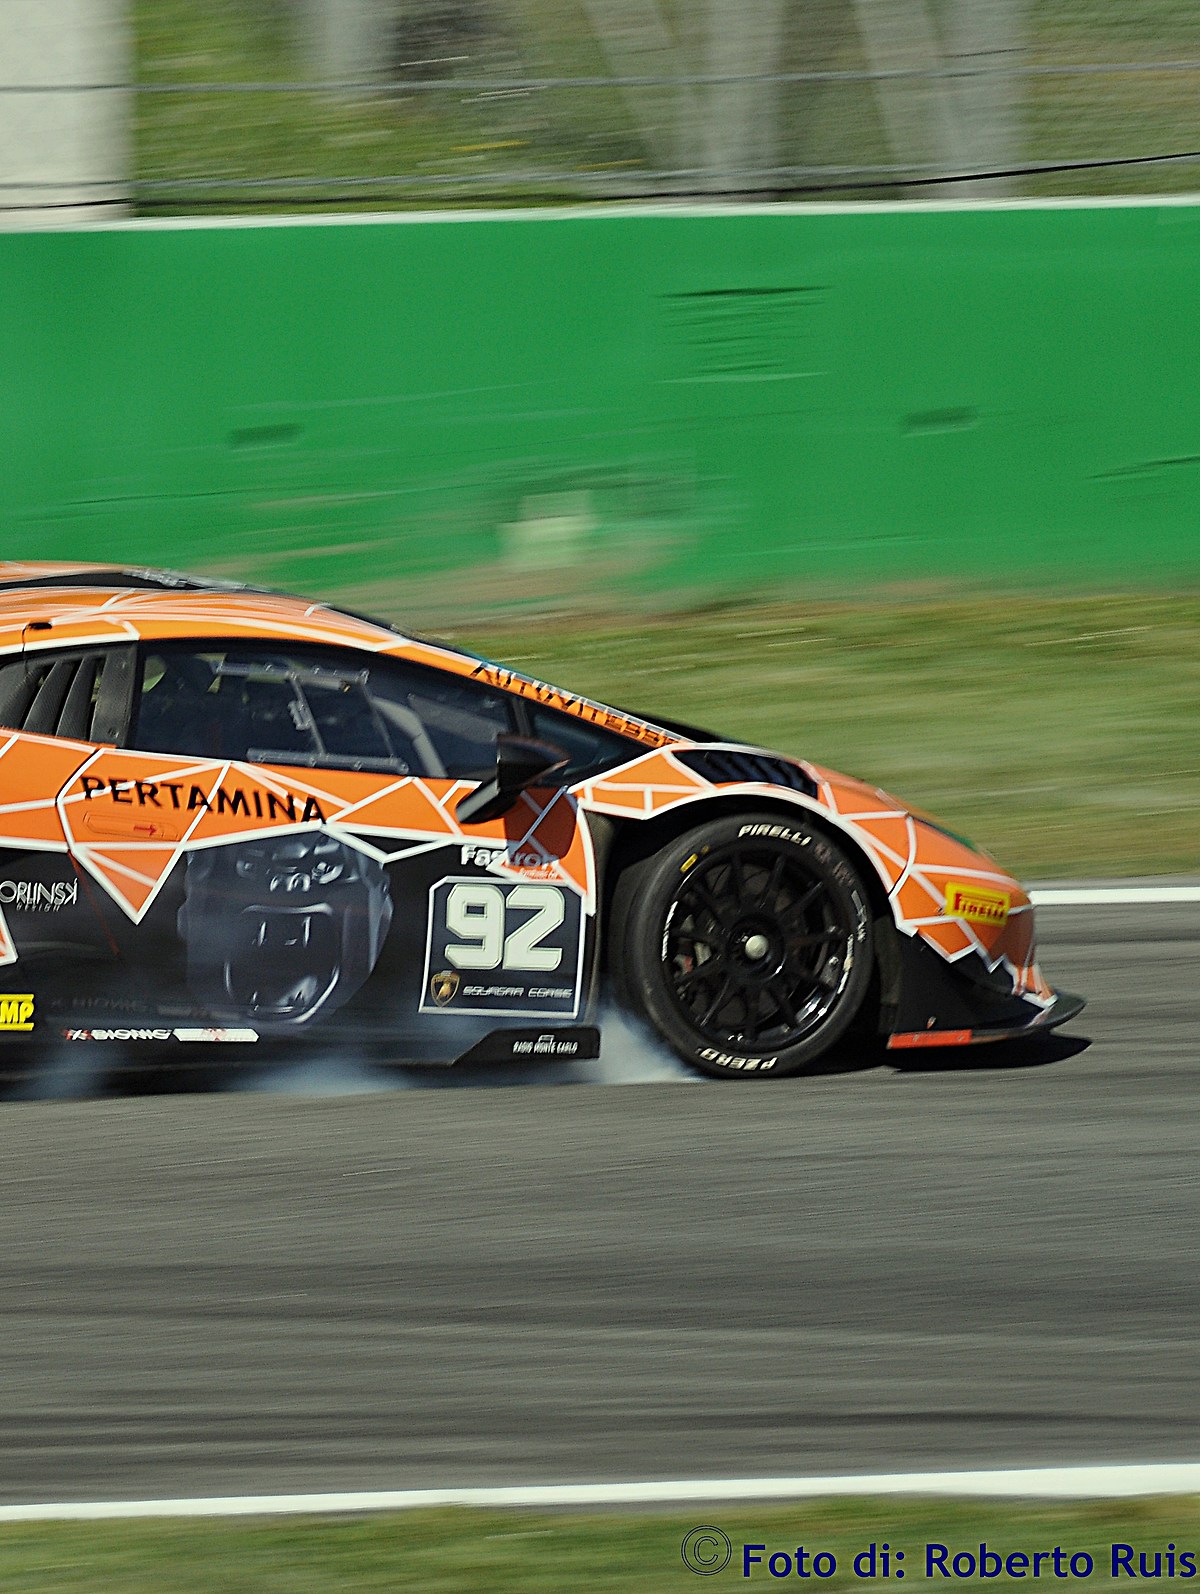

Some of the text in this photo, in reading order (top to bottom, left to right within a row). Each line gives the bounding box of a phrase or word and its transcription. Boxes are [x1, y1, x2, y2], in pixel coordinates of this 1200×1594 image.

[80, 776, 327, 825] PERTAMINA
[738, 823, 812, 846] PIRELLI
[954, 892, 1005, 918] PIRELLI
[444, 883, 566, 971] 92
